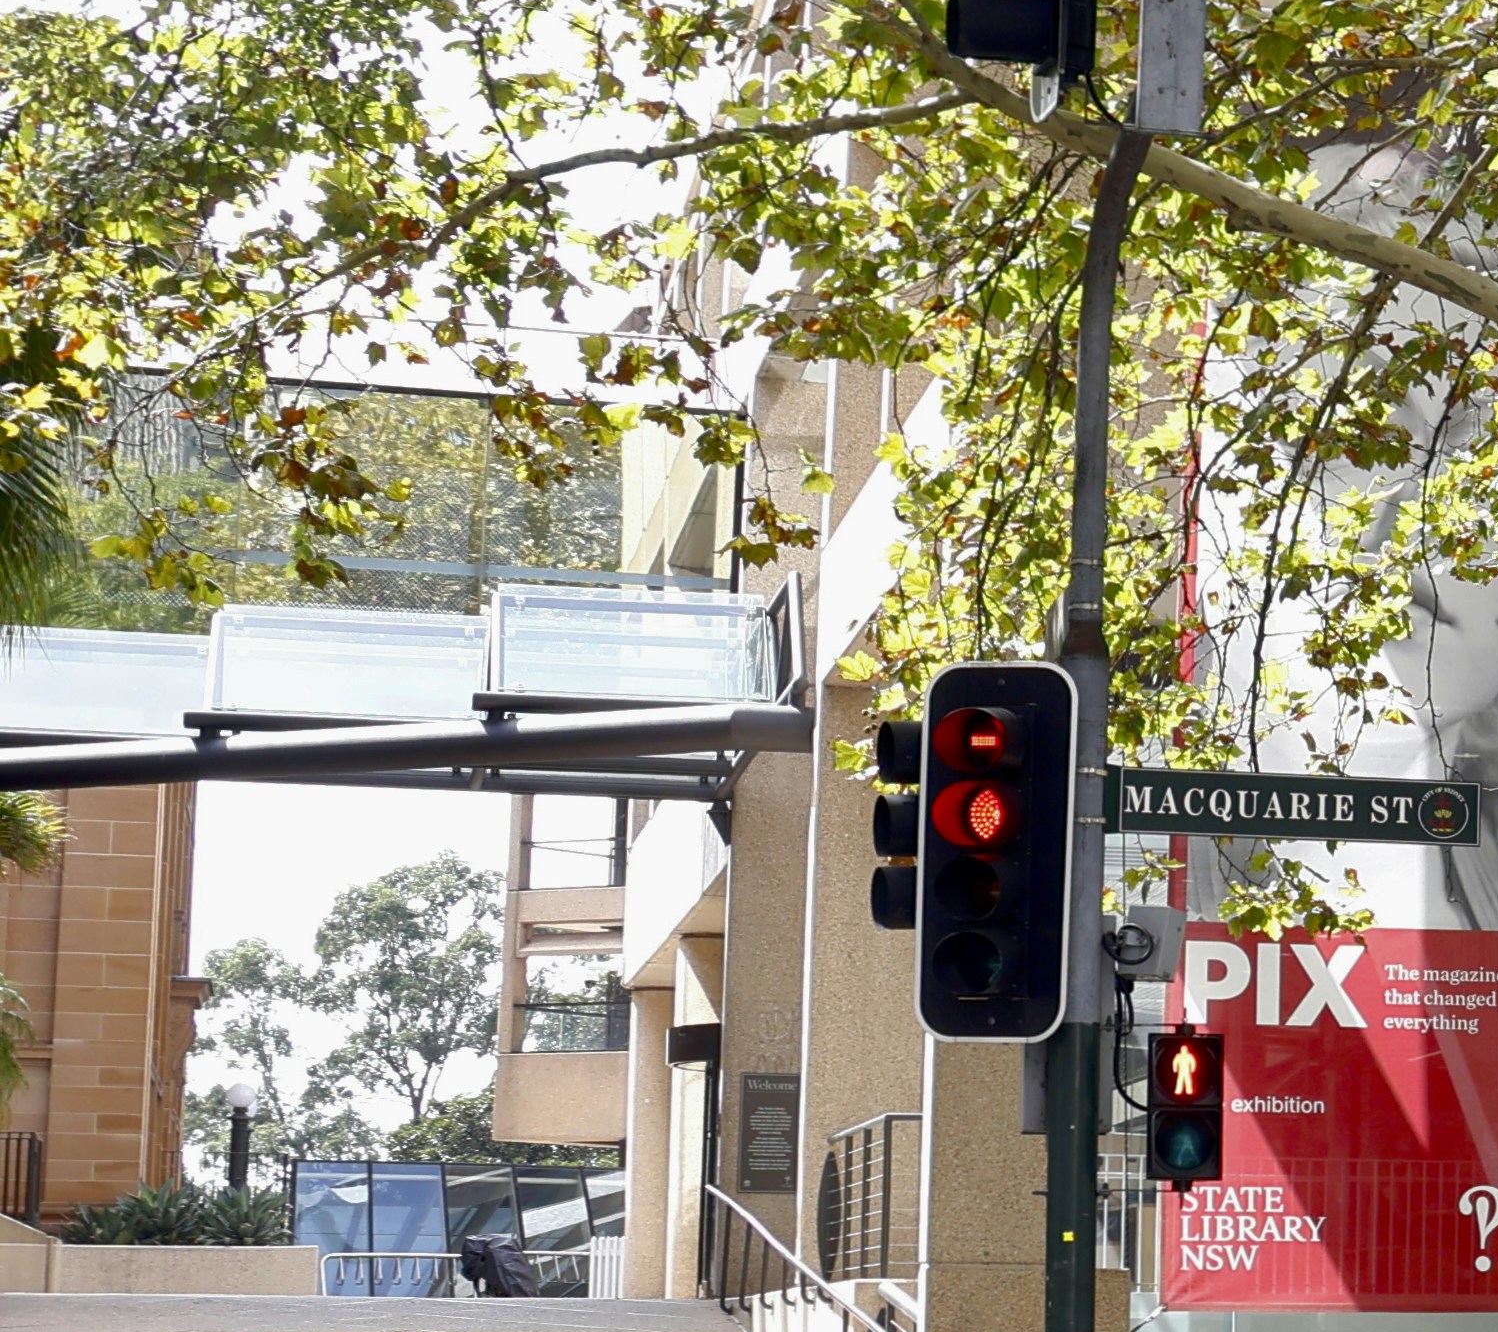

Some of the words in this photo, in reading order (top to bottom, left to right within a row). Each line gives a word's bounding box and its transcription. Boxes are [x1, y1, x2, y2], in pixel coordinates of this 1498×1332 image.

[1124, 785, 1353, 821] MACQUARIE
[1370, 795, 1413, 824] ST
[1184, 940, 1368, 1028] PIX
[1384, 964, 1419, 982] The
[1384, 988, 1420, 1005] that
[1424, 989, 1497, 1008] changed
[1384, 1015, 1479, 1034] everything
[747, 1079, 797, 1090] Welcome
[1231, 1096, 1325, 1114] exhibition
[1181, 1186, 1284, 1213] STATE
[1180, 1216, 1327, 1242] LIBRARY
[1180, 1245, 1259, 1271] NSW
